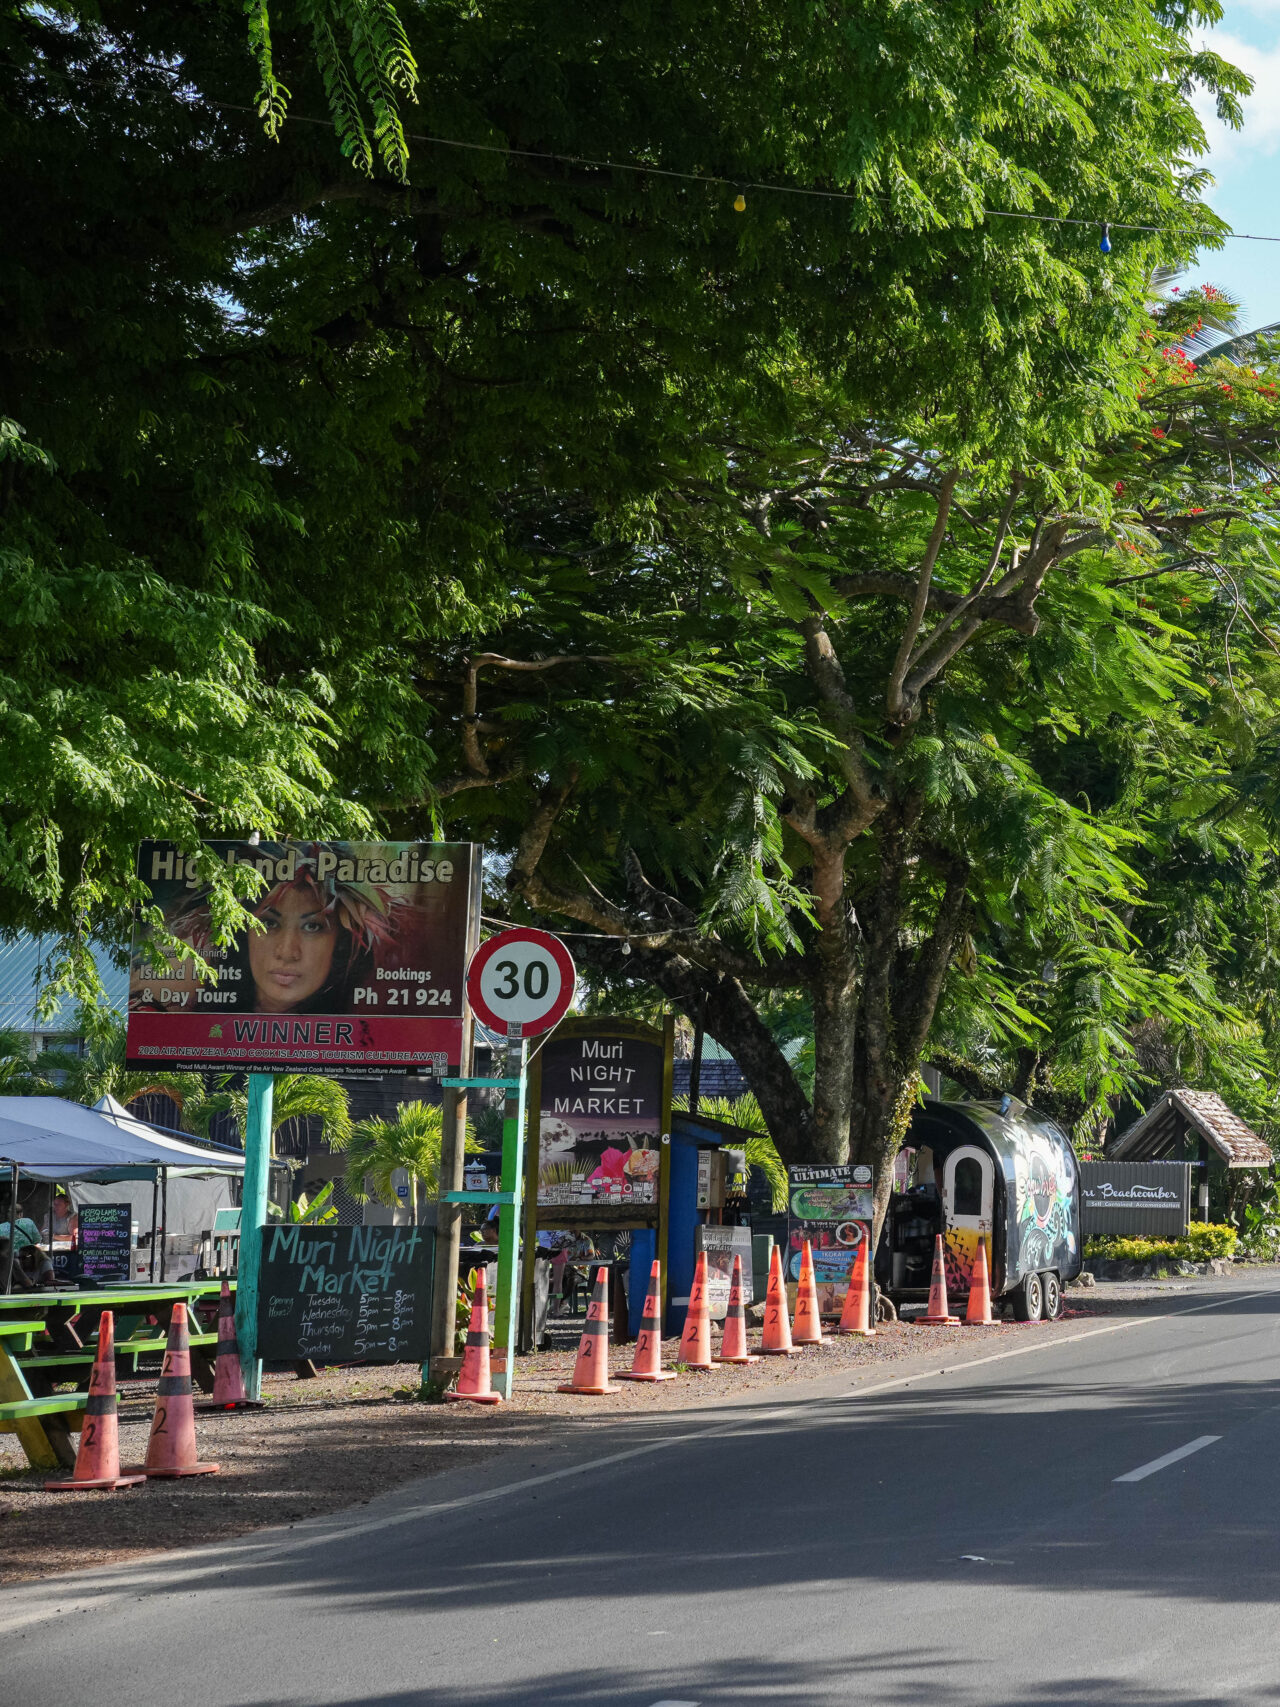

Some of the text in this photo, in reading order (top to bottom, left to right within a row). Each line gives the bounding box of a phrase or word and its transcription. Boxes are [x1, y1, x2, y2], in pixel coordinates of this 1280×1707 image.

[317, 850, 455, 883] Paradise
[376, 967, 432, 983] Bookings
[493, 960, 549, 1000] 30
[142, 988, 237, 1007] & Day Tours
[353, 987, 452, 1006] Ph 21 924
[233, 1020, 354, 1046] WINNER
[160, 1047, 177, 1056] AIR
[178, 1047, 201, 1056] NEW
[202, 1047, 246, 1058] ZEALAND
[247, 1049, 277, 1058] COOK
[278, 1049, 319, 1059] ISLANDS
[321, 1050, 364, 1060] TOURISM
[365, 1051, 410, 1061] CULTURE
[411, 1052, 448, 1062] AWARD
[582, 1040, 623, 1059] Muri
[177, 1063, 194, 1071] Proud
[570, 1065, 636, 1083] NIGHT
[553, 1097, 645, 1114] MARKET
[794, 1166, 851, 1182] ULTIMATE
[1096, 1182, 1178, 1199] Beachcomber
[269, 1226, 422, 1274] Muri Night
[299, 1263, 395, 1294] Market
[770, 1276, 778, 1292] 2
[307, 1290, 415, 1306] Tuesday 5pm 8pm
[694, 1287, 703, 1302] 2
[302, 1304, 353, 1322] Wednesday
[360, 1305, 379, 1317] 5pm
[589, 1304, 599, 1318] 2
[770, 1310, 779, 1325] 2
[798, 1301, 811, 1316] 2
[300, 1316, 414, 1339] Thursday 5pm 8pm
[688, 1326, 700, 1342] 2
[298, 1337, 331, 1357] Sunday
[354, 1338, 376, 1355] 5pm
[583, 1341, 593, 1358] 2
[639, 1334, 650, 1352] 2
[162, 1354, 173, 1374] 2
[91, 1369, 101, 1387] 2
